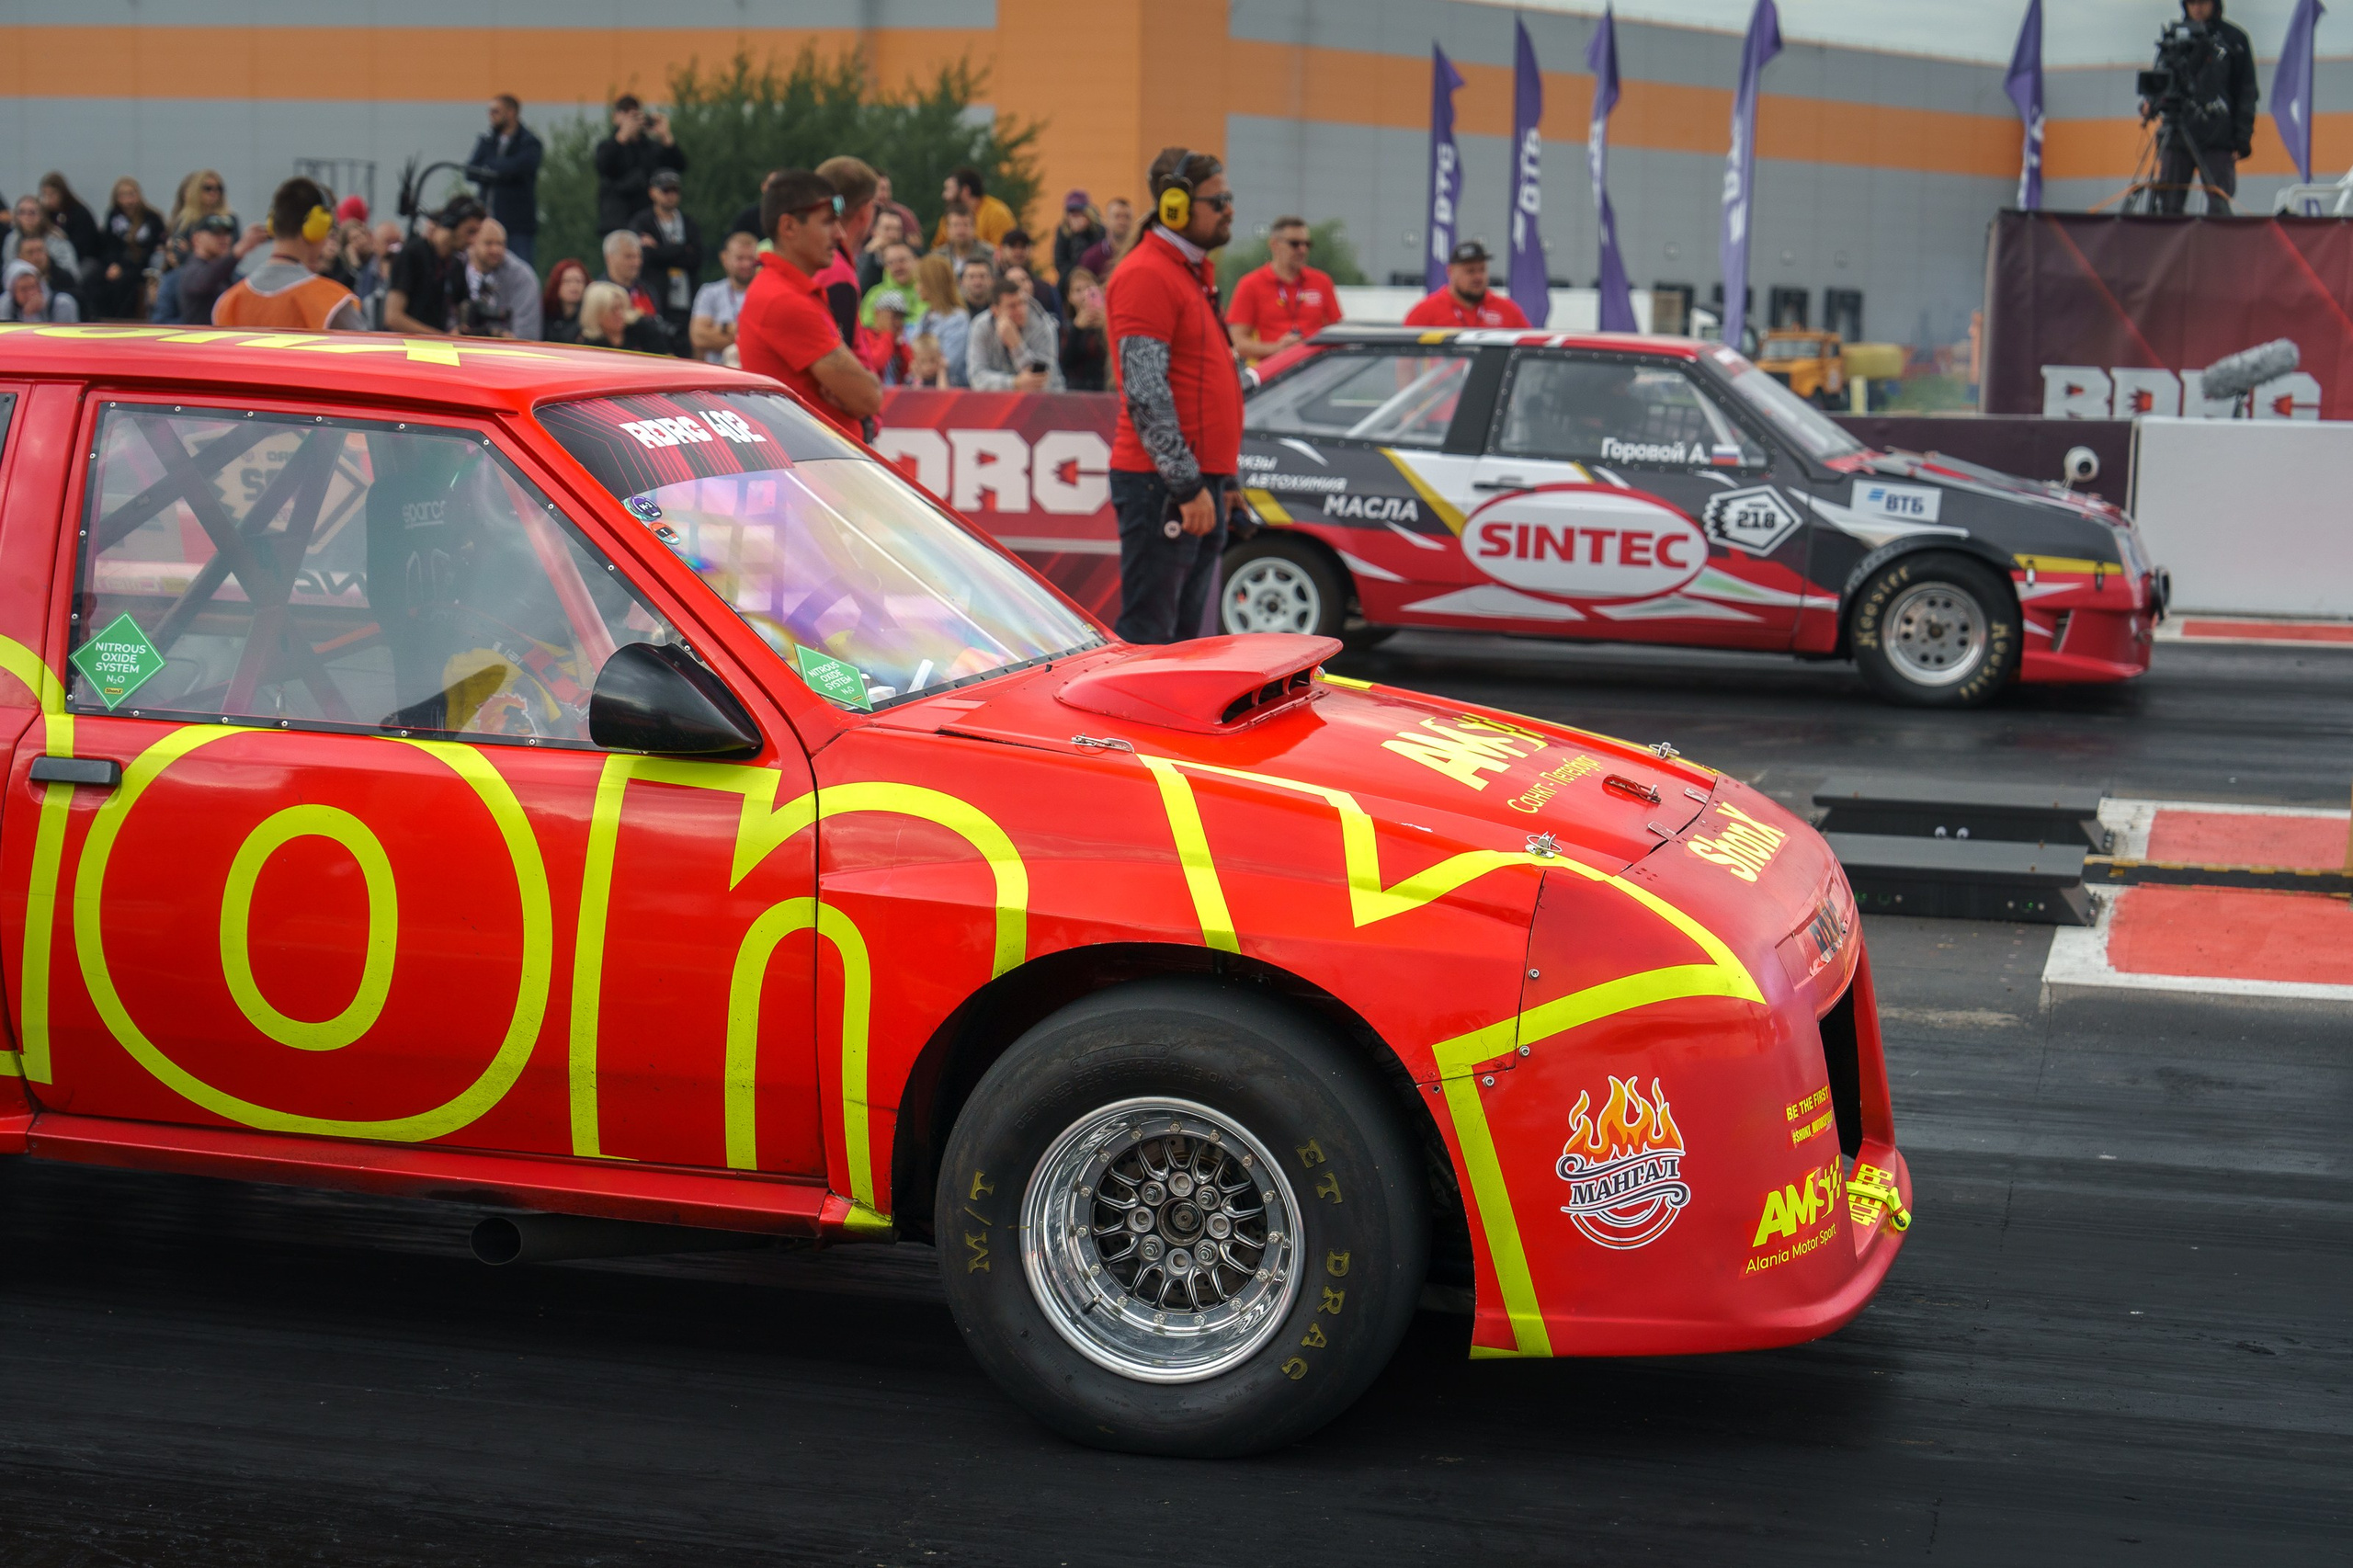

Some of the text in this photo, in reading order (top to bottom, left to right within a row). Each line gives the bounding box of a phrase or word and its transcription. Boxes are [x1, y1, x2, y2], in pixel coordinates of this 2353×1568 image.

[619, 410, 767, 449] RDRC 402
[1601, 437, 1687, 464] Горовой
[1246, 473, 1347, 493] АВТОХИМИЯ
[1324, 494, 1418, 522] МАСЛА
[1885, 494, 1925, 515] ВТБ
[1737, 510, 1775, 529] 218
[1478, 521, 1692, 569] SINTEC
[95, 642, 146, 654] NITROUS
[101, 652, 137, 664] OXIDE
[95, 662, 140, 674] SYSTEM
[807, 661, 840, 677] NITROUS
[820, 669, 844, 683] OXIDE
[824, 676, 854, 690] SYSTEM
[1687, 801, 1786, 882] ShonX
[1786, 1085, 1829, 1121] BE THE FIRST
[1570, 1157, 1680, 1207] МАНГАЛ
[1281, 1135, 1351, 1381] ET DRAG
[1745, 1222, 1836, 1275] Alania Motor Sport
